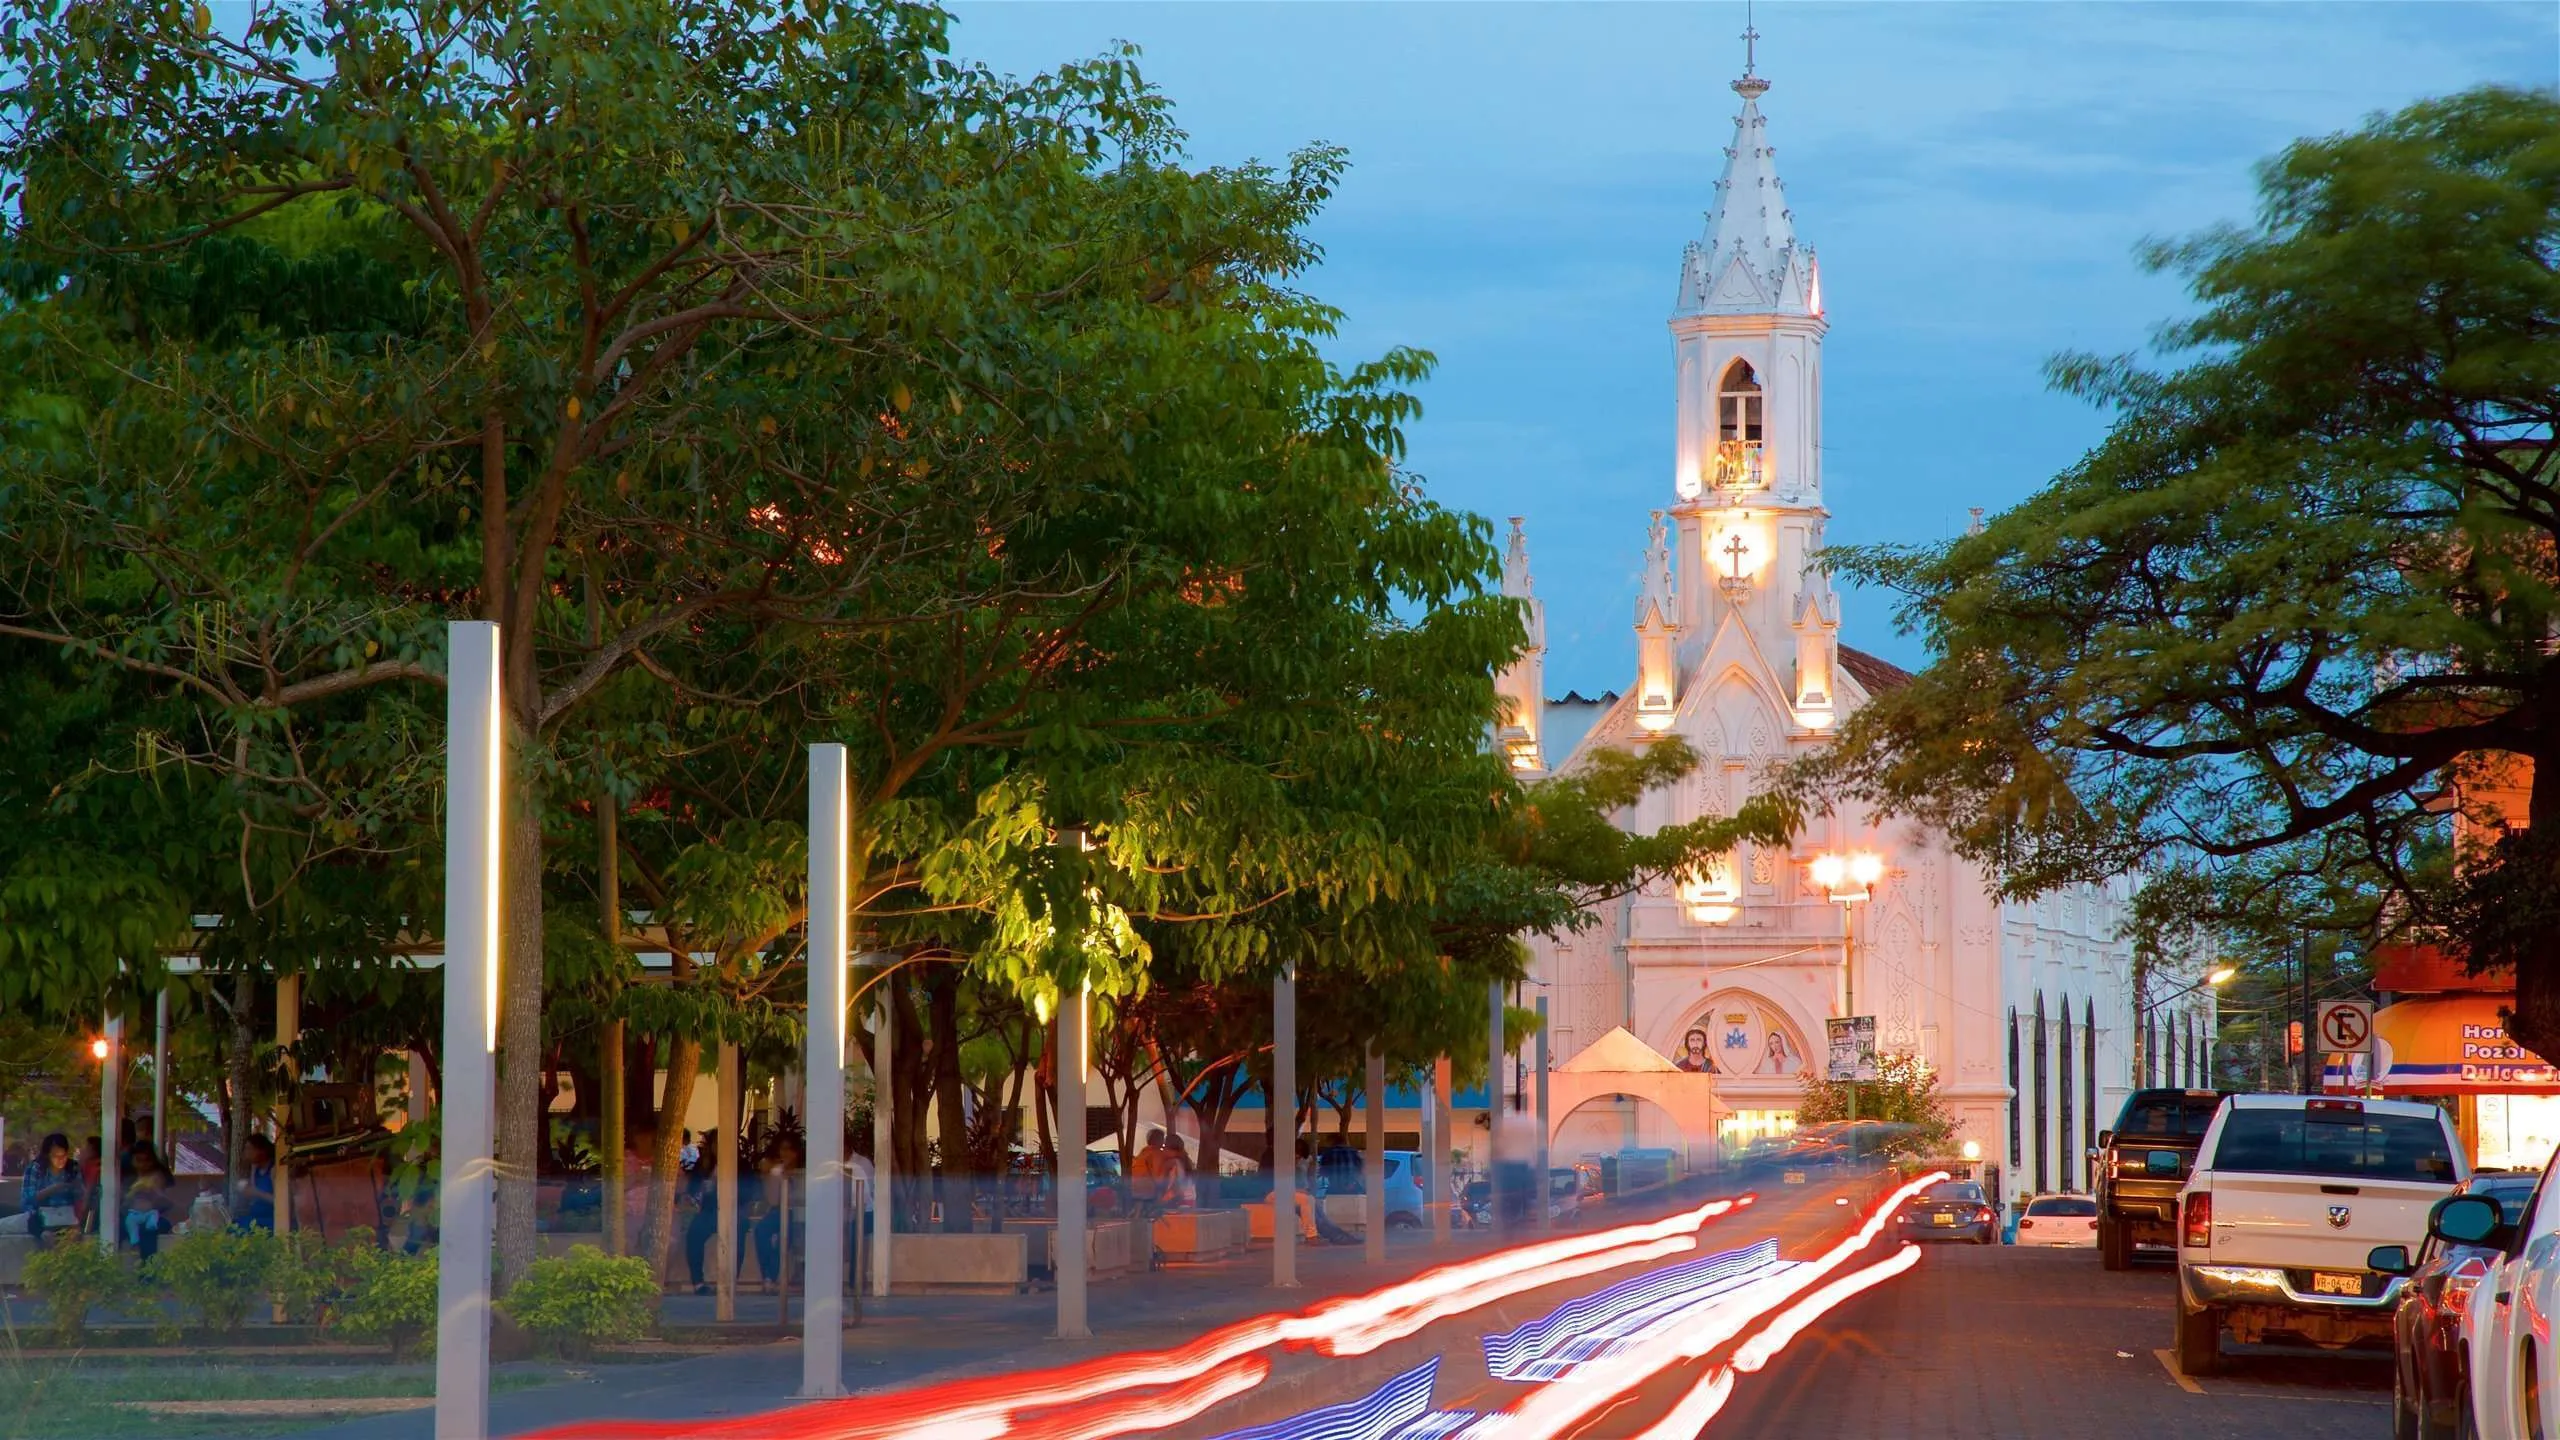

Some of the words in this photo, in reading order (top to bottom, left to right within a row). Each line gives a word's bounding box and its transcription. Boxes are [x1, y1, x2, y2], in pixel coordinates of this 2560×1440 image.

[2463, 1024, 2510, 1039] Hor
[2464, 1043, 2526, 1059] Pozol
[2461, 1064, 2537, 1081] Dulces
